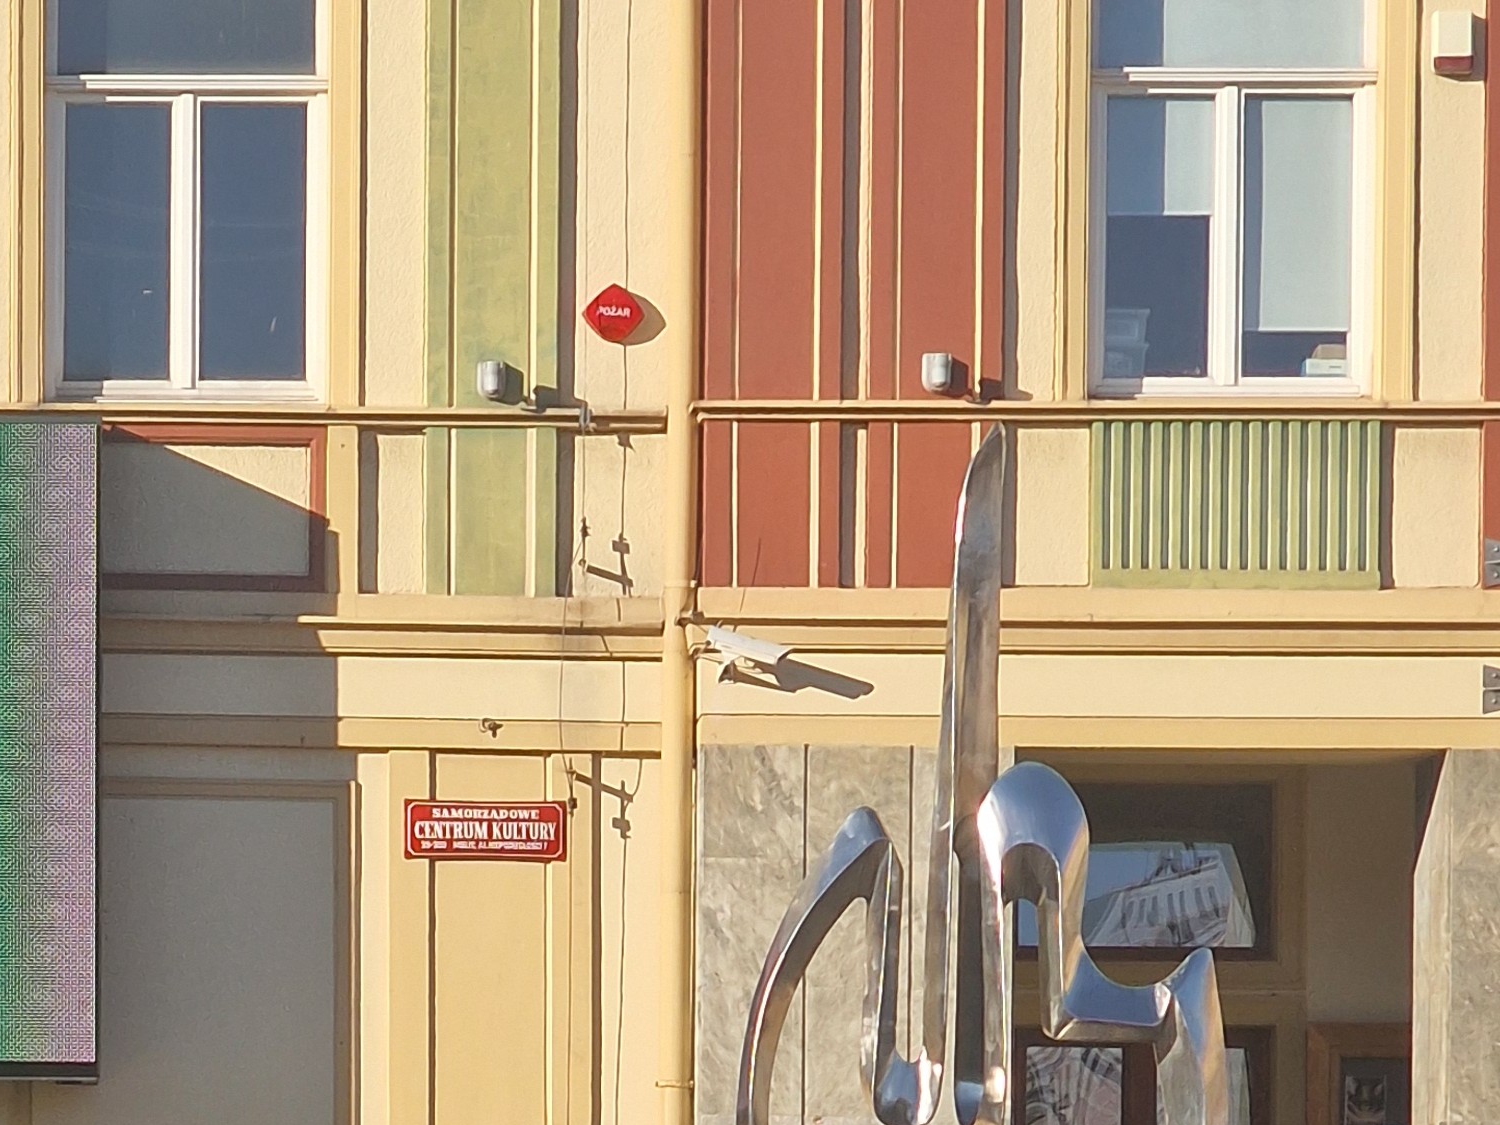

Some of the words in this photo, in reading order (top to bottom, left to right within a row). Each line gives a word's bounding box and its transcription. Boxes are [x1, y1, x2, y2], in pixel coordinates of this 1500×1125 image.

[596, 305, 631, 318] POŻAR
[432, 808, 539, 820] SAMORZĄDOWE
[414, 821, 488, 840] CENTRUM
[492, 821, 557, 841] KULTURY
